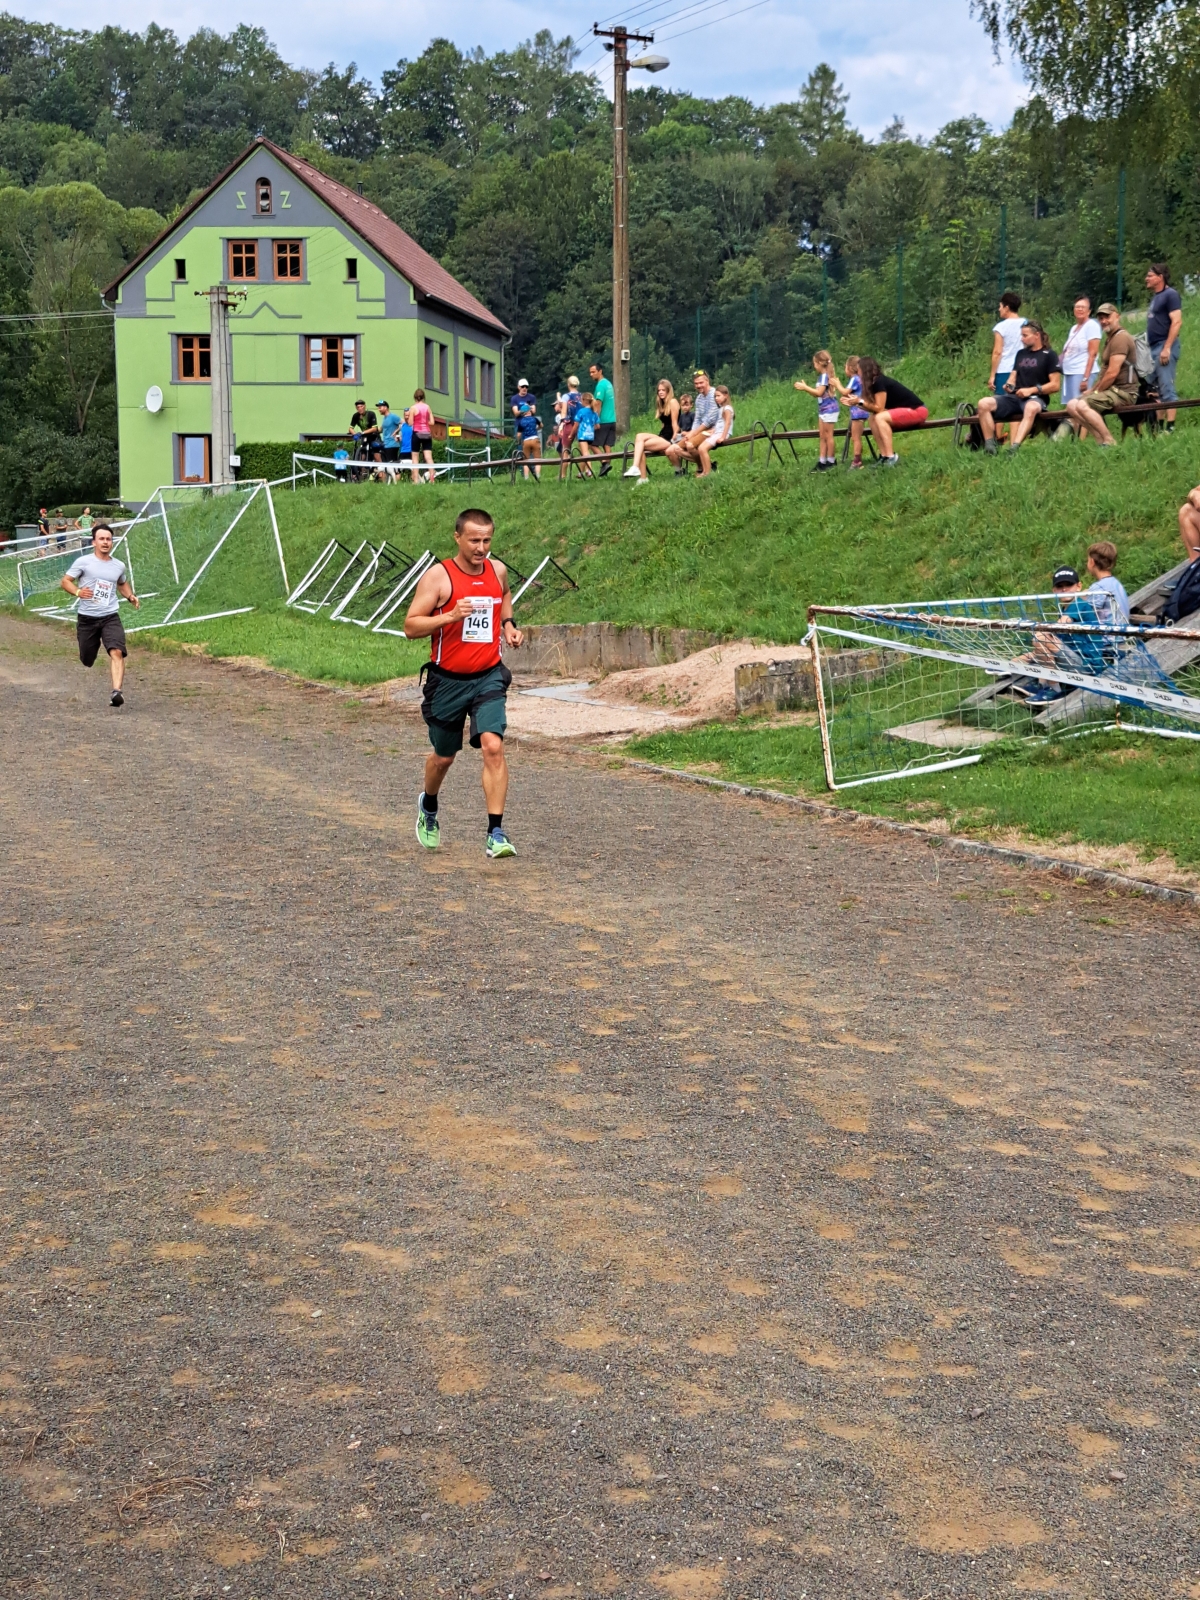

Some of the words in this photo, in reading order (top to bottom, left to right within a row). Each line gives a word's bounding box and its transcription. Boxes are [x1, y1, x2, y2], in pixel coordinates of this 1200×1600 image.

[280, 190, 292, 209] Z
[95, 589, 109, 599] 296
[467, 617, 489, 629] 146
